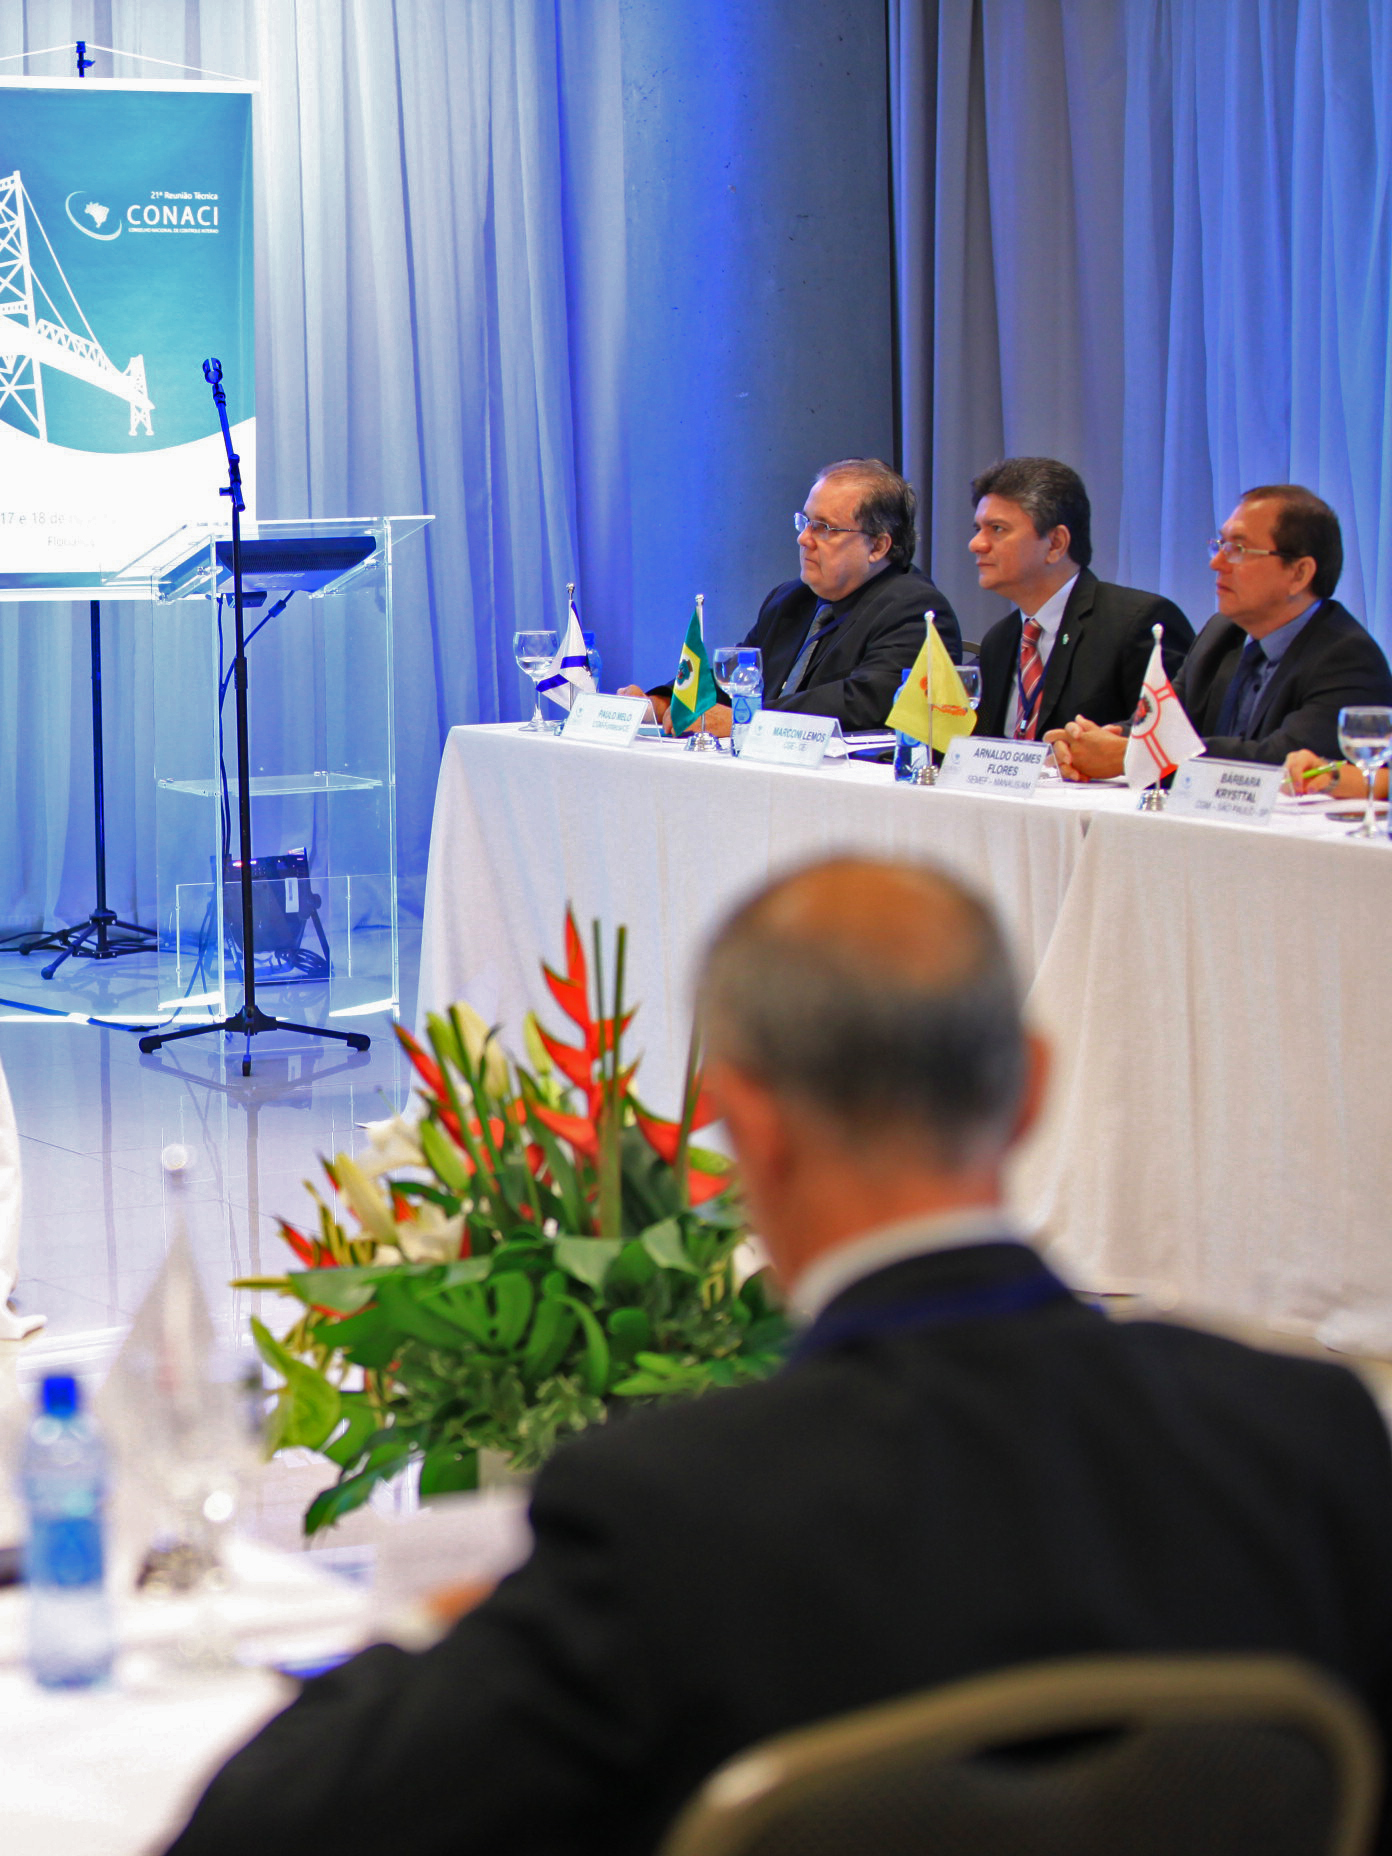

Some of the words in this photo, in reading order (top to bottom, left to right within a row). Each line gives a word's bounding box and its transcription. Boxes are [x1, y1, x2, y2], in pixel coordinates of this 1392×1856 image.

[164, 191, 193, 200] Reunião
[193, 191, 218, 200] Técnica
[127, 204, 219, 226] CONACI
[1, 511, 15, 525] 17
[18, 514, 27, 525] e
[32, 511, 46, 525] 18
[49, 512, 66, 525] de
[598, 709, 617, 720] PAULO
[617, 711, 633, 722] MELO
[773, 727, 803, 741] MARCONI
[802, 731, 827, 743] LEMOS
[973, 747, 1012, 761] ARNALDO
[1012, 752, 1042, 765] GOMES
[987, 763, 1020, 777] FLORES
